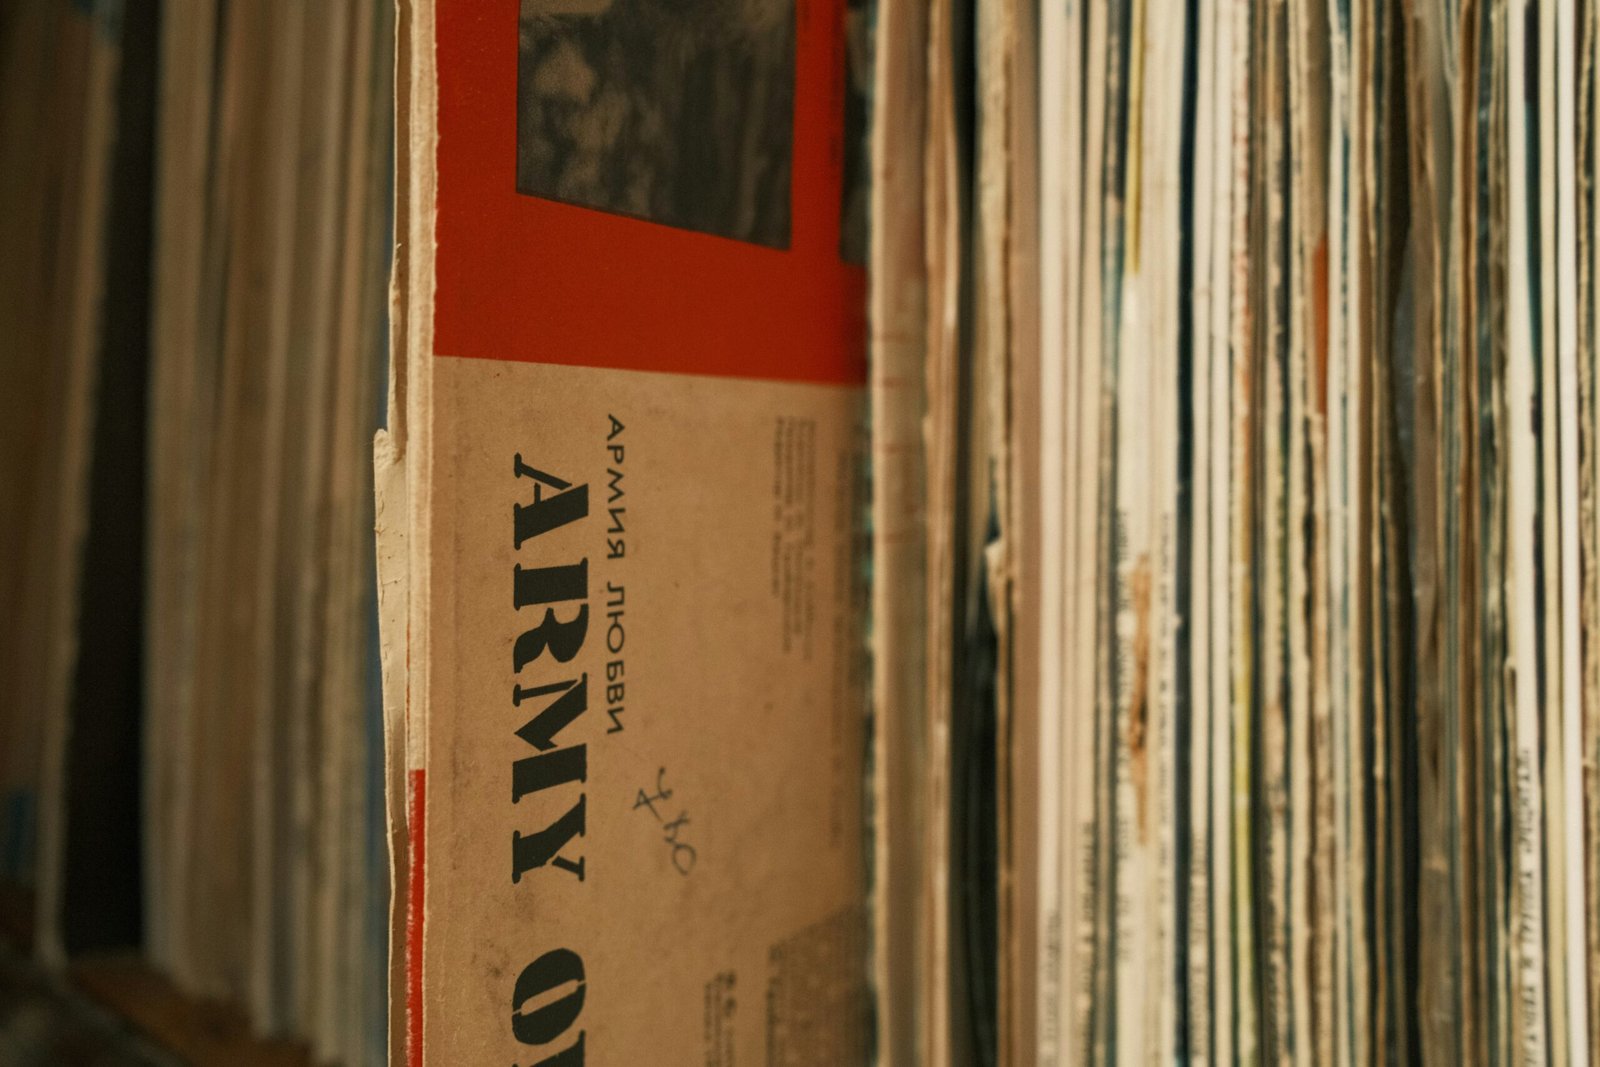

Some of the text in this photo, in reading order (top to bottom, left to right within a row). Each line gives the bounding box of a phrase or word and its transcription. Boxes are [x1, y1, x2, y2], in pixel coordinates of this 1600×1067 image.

[512, 453, 589, 1067] ARMY O
[606, 413, 626, 735] АРМИЯ ЛЮБВИ
